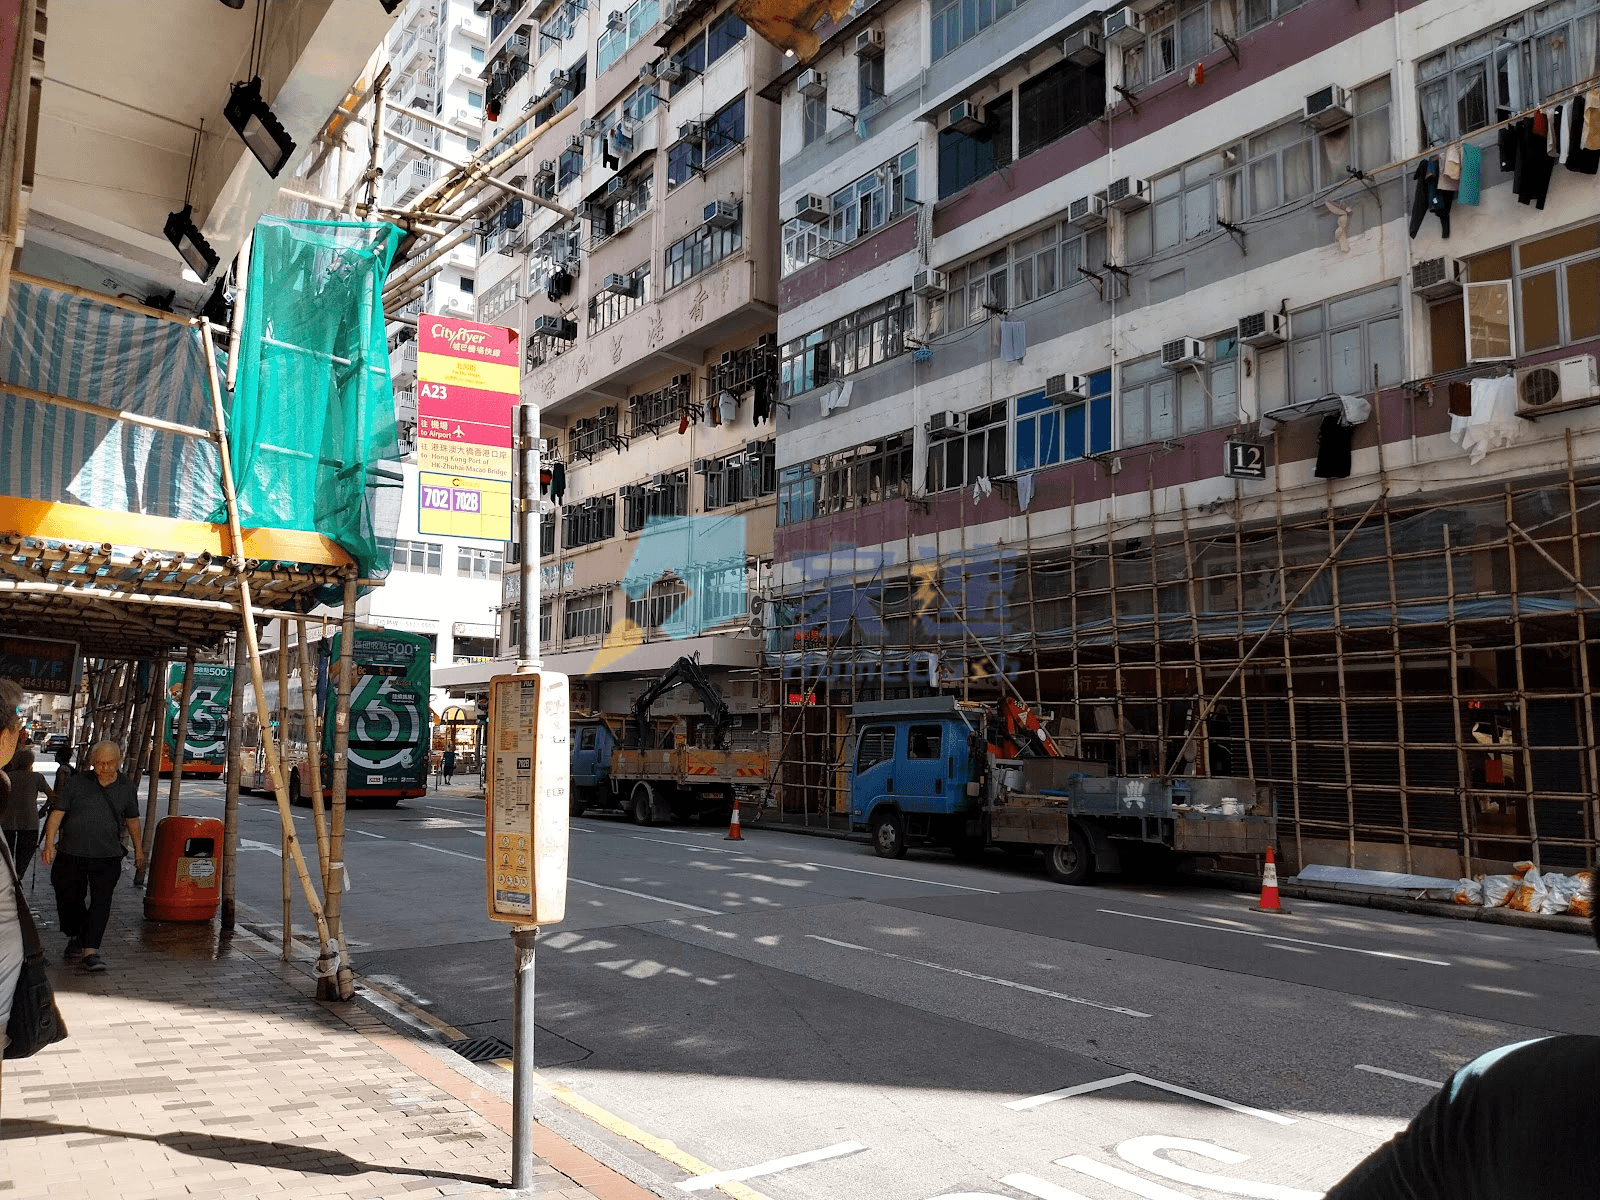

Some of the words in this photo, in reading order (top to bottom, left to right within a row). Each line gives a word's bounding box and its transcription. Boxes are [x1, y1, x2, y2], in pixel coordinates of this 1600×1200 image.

[431, 323, 486, 344] Cityflyer
[420, 383, 448, 400] A23
[430, 419, 448, 431] 機場
[429, 429, 452, 439] Airport
[431, 442, 507, 459] 港珠澳大橋香港口岸
[431, 453, 449, 462] Hong
[450, 455, 467, 465] Kong
[468, 457, 481, 465] Port
[1234, 445, 1262, 470] 12
[487, 467, 508, 476] Bridge
[423, 487, 449, 508] 702
[454, 490, 479, 512] 702B
